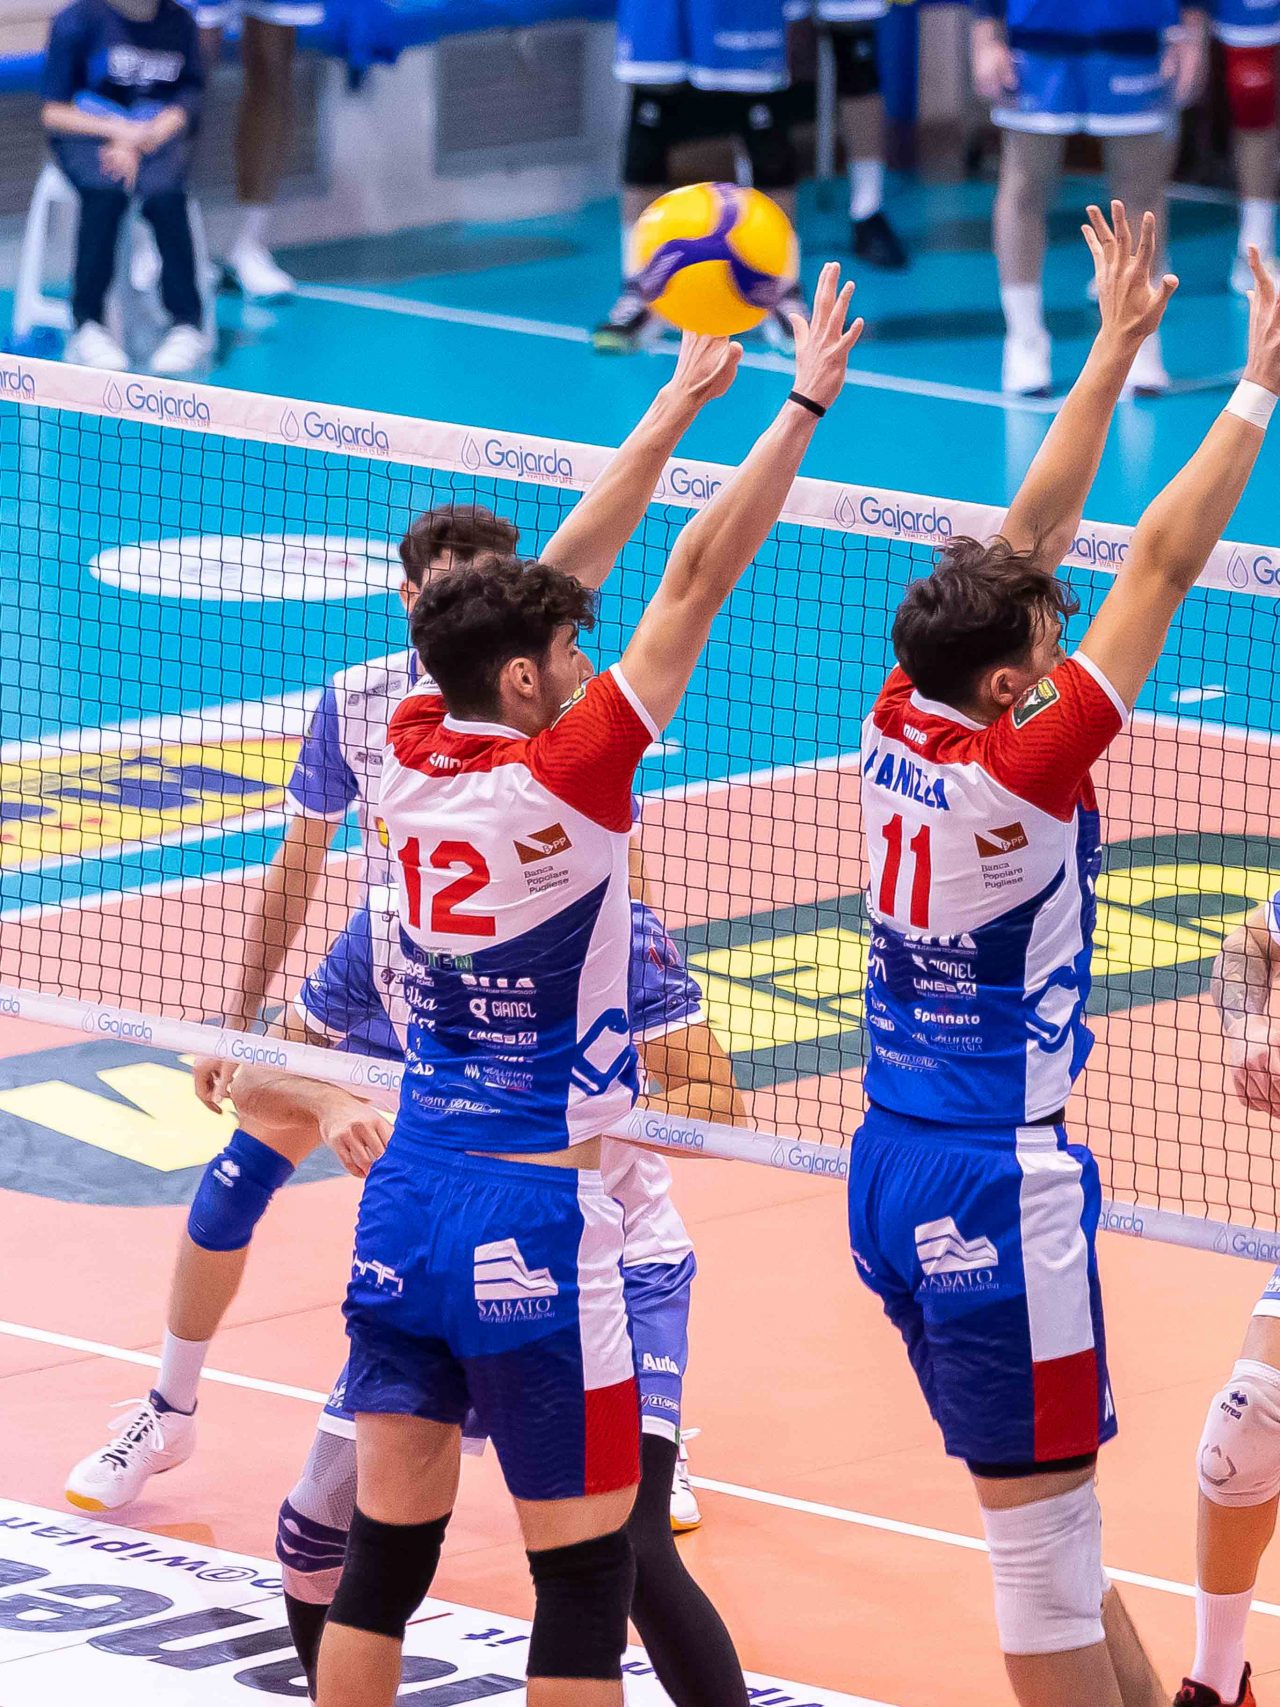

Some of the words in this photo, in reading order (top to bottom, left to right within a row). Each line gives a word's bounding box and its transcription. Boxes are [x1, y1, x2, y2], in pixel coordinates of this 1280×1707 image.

[126, 383, 211, 420] Gajarda
[303, 411, 389, 449] Gajarda
[485, 439, 573, 477] Gajarda
[860, 496, 952, 537] Gajarda
[903, 723, 929, 746] nine
[524, 865, 554, 879] Banca
[526, 869, 569, 886] Popolare
[879, 813, 931, 930] 11
[981, 862, 1010, 873] Banca
[983, 867, 1023, 881] Popolare
[397, 836, 497, 937] 12
[529, 878, 569, 894] Pugliese
[985, 876, 1023, 890] Pugliese
[97, 1014, 153, 1041] Gajarda
[914, 1008, 980, 1025] Spennato
[231, 1039, 288, 1067] Gajarda
[645, 1119, 704, 1149] Gajarda
[788, 1148, 848, 1176] Gajarda
[477, 1297, 551, 1317] SABATO
[643, 1352, 679, 1375] Auto
[1220, 1402, 1242, 1420] errea
